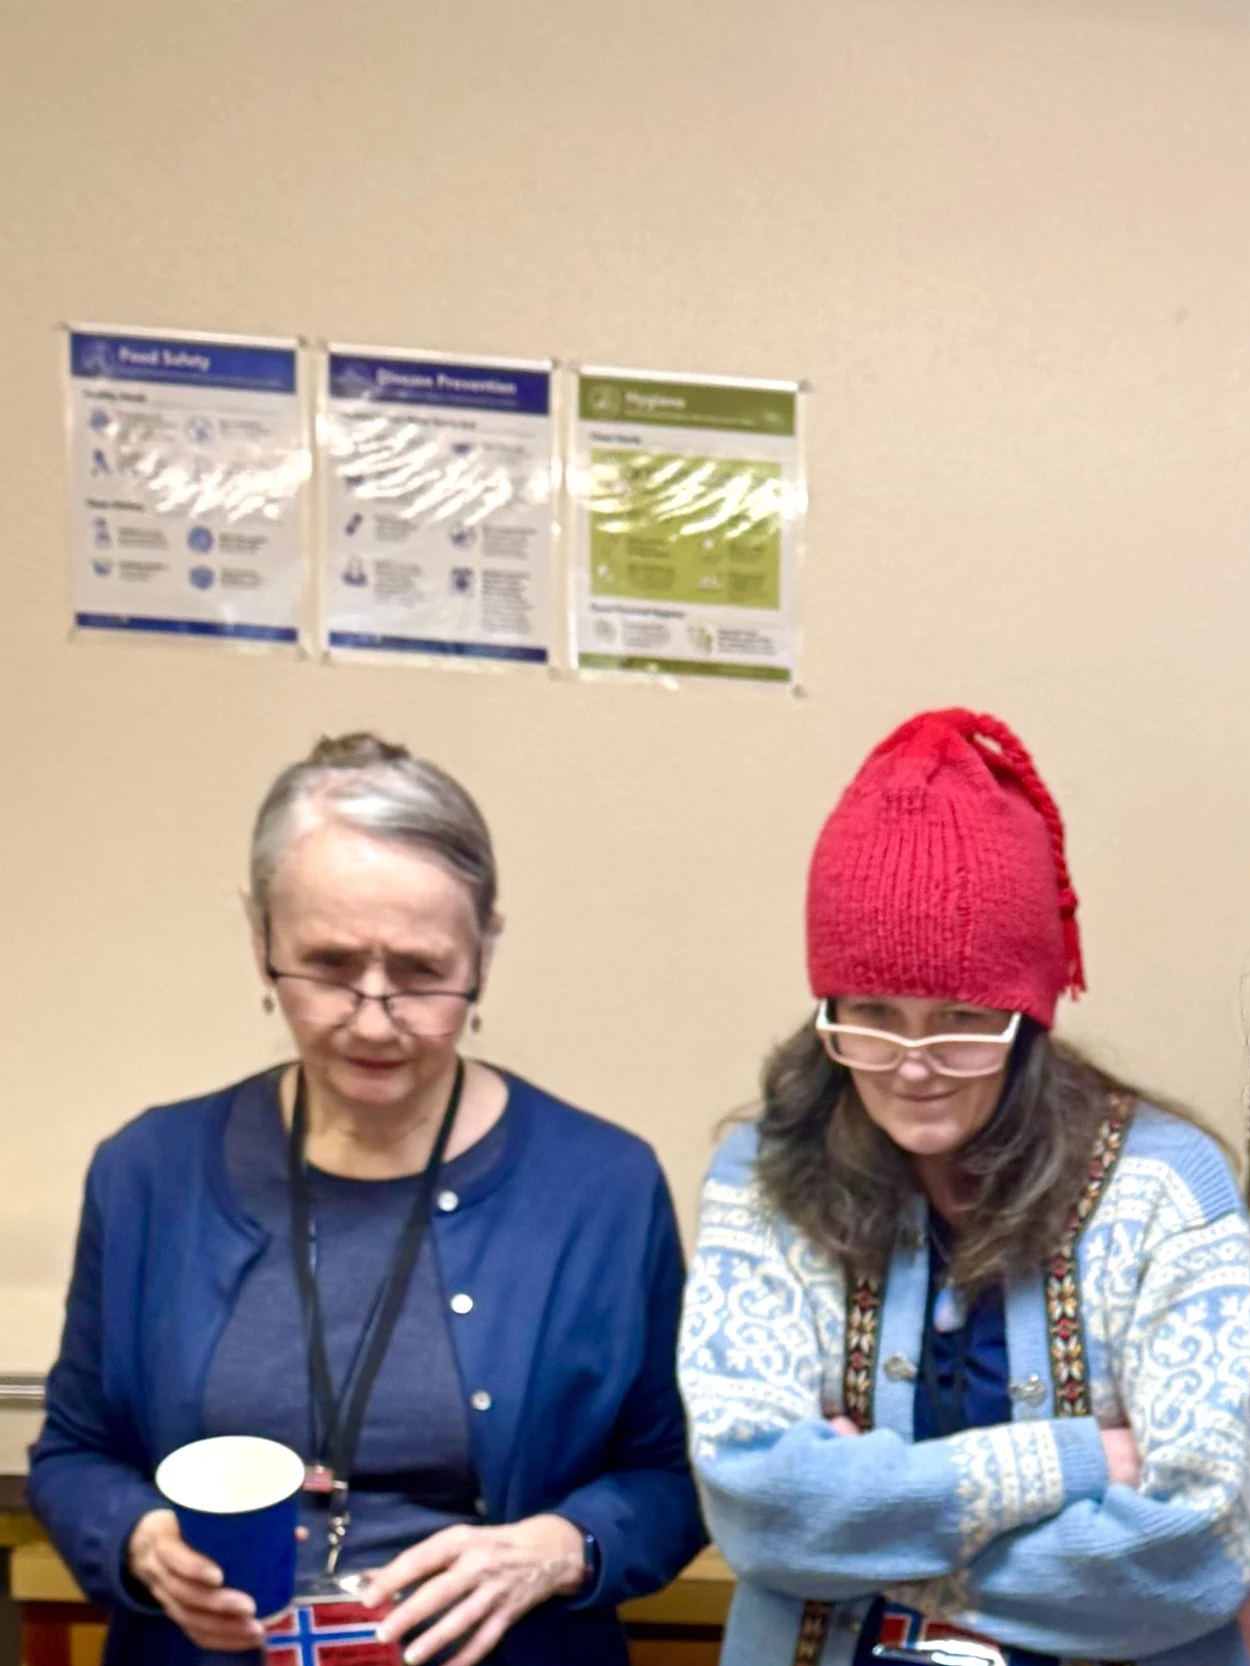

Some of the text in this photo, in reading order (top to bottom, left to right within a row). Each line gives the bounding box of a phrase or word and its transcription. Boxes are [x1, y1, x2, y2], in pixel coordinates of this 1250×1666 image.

[118, 346, 211, 372] Food Safety
[435, 372, 518, 396] Prevention
[624, 391, 686, 411] Hygiene
